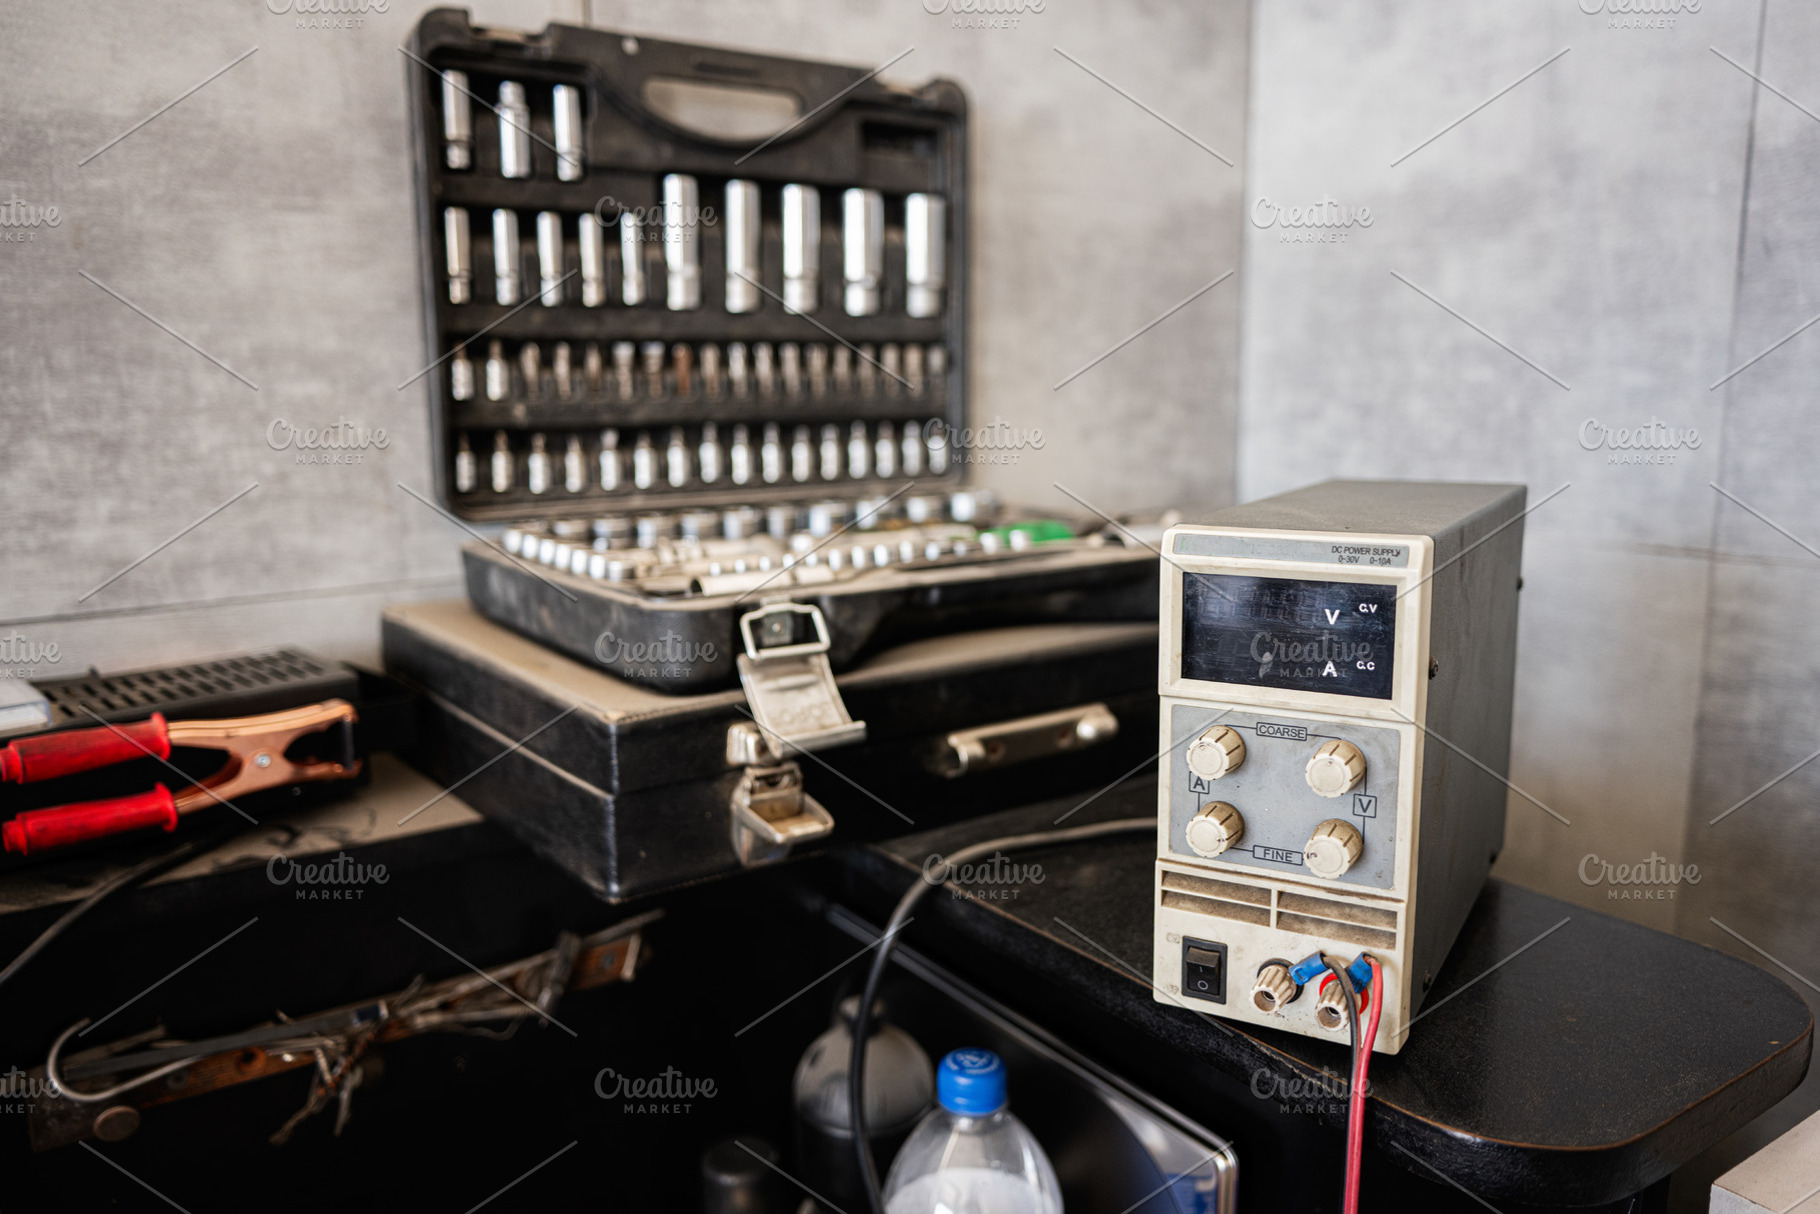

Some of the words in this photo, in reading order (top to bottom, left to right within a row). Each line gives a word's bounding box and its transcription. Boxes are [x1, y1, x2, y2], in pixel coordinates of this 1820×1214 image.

[1331, 546, 1342, 554] DC
[1343, 546, 1371, 555] POWER
[1372, 548, 1400, 557] SUPPLY
[1324, 608, 1340, 625] V
[1322, 660, 1338, 677] A
[1259, 725, 1305, 739] COARSE
[1193, 776, 1206, 791] A
[1358, 798, 1372, 813] V
[1263, 849, 1293, 862] FINE
